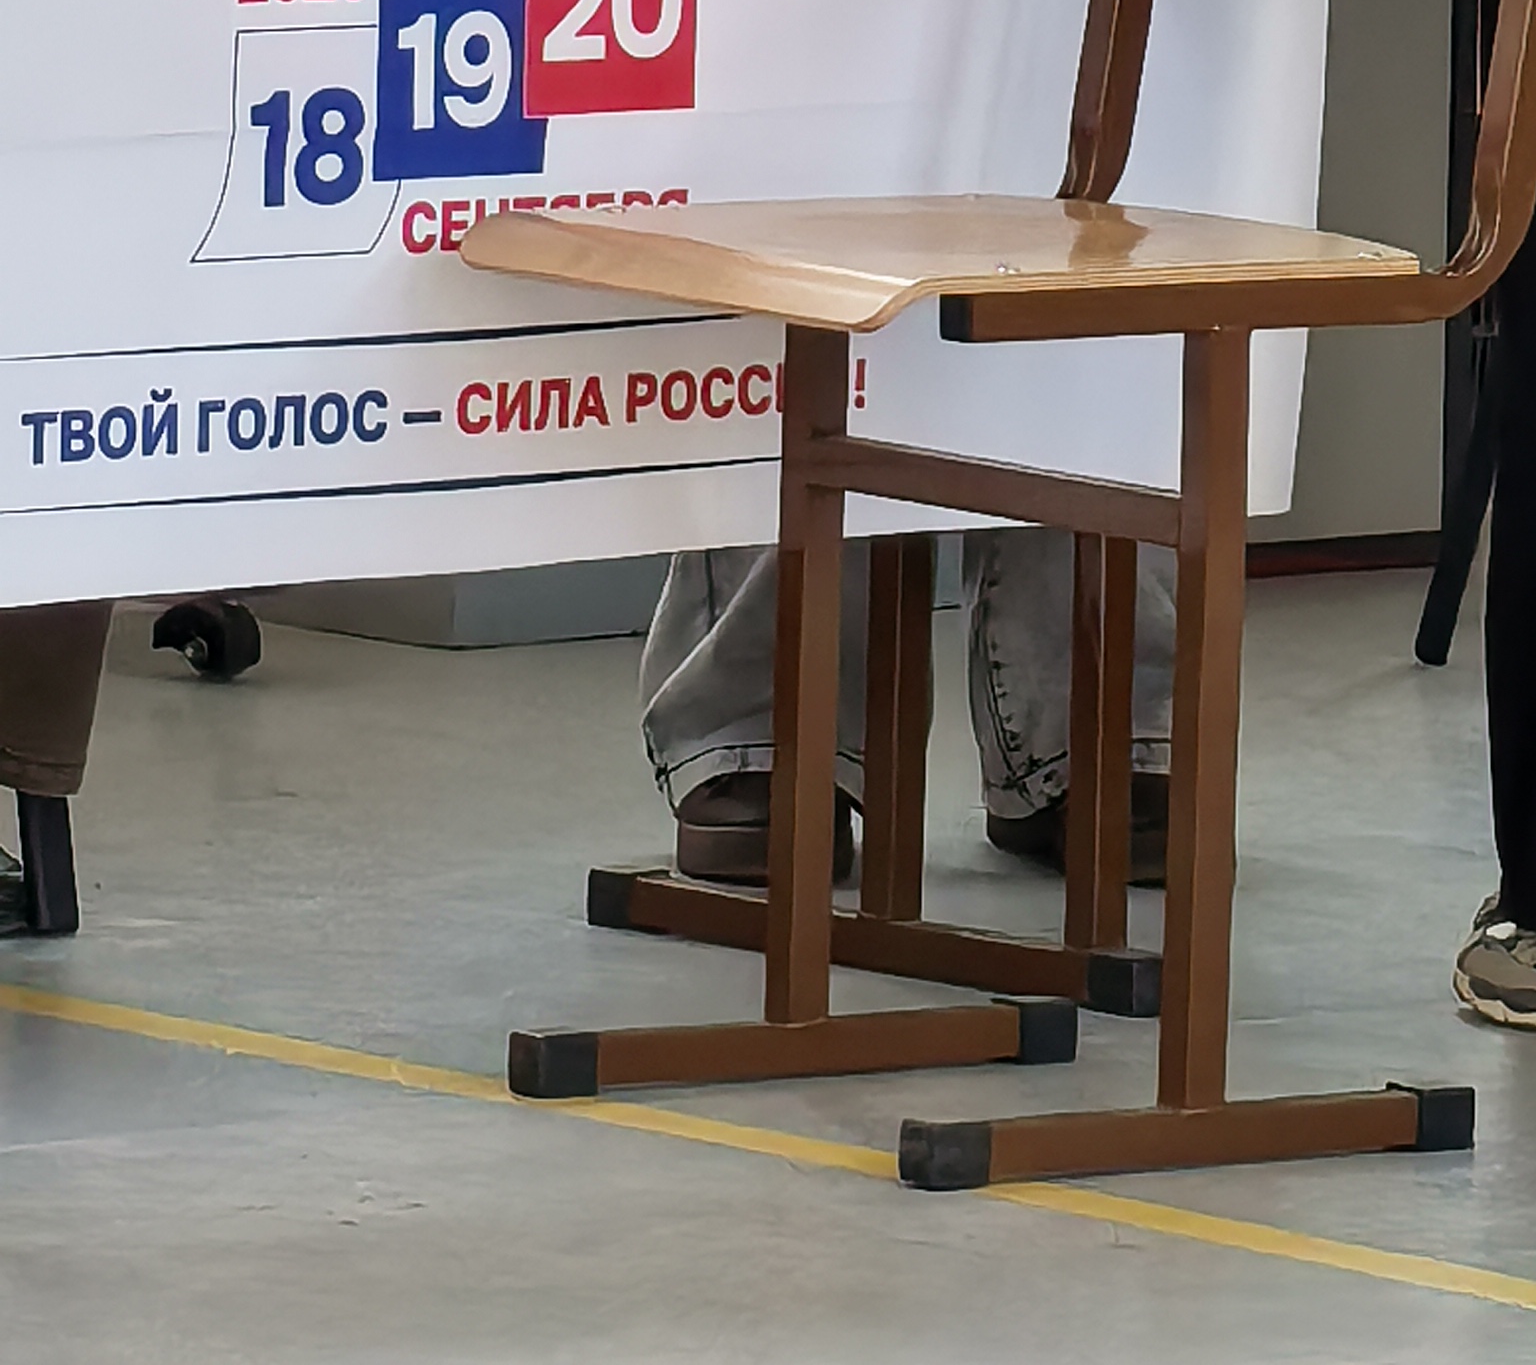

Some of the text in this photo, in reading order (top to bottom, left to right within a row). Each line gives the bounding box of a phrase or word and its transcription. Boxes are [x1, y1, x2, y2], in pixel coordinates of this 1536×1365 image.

[398, 11, 511, 130] 19
[251, 88, 365, 207] 18
[22, 389, 177, 465] ТВОЙ
[198, 391, 387, 453] ГОЛОС
[457, 376, 610, 434] СИЛА
[626, 359, 867, 423] РОСС!
